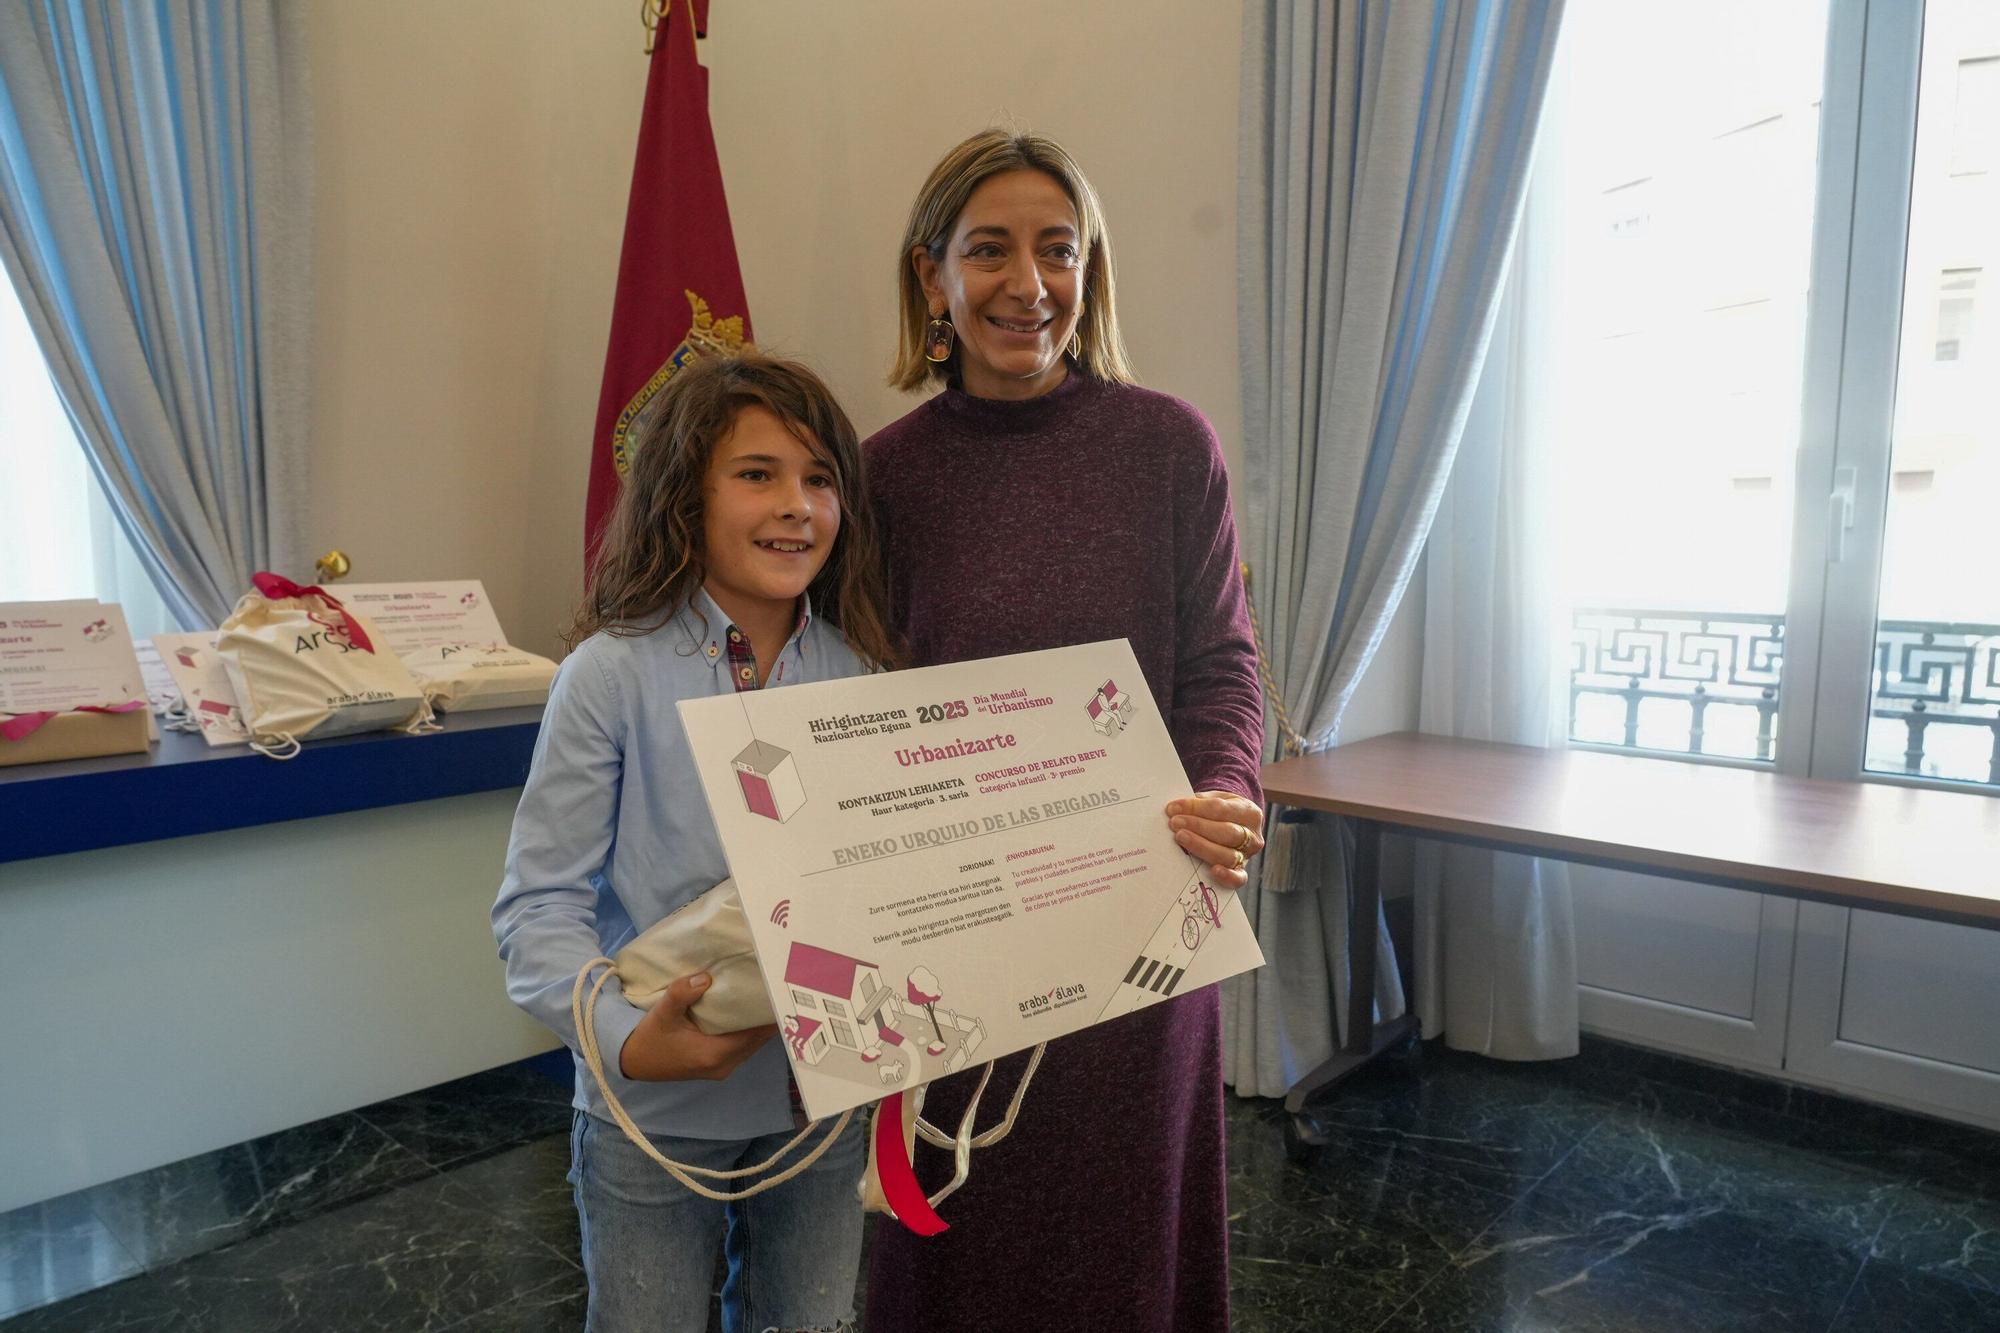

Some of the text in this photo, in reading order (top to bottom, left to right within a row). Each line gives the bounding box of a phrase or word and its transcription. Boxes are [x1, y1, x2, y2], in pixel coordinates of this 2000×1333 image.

[988, 696, 1053, 714] Urbanismo
[991, 688, 1027, 701] Mundial
[809, 700, 968, 732] Hirigintzaren 2025
[814, 722, 911, 743] Nazioarteko Eguna
[895, 734, 1016, 767] Urbanizarte
[975, 749, 1107, 782] CONCURSO DE RELATO BREVE
[1018, 774, 1046, 786] infantil
[1060, 766, 1085, 779] premio
[838, 778, 965, 810] KONTAKIZUN LEHIAKETA
[872, 807, 892, 816] Haur
[894, 797, 935, 811] kategoria
[949, 790, 969, 801] saria
[832, 788, 1120, 865] ENEKO URQUIJO DE LAS REIGADAS
[959, 859, 994, 873] ZORIONAK!
[1021, 863, 1052, 876] creatividad
[1065, 854, 1087, 864] manera
[1096, 847, 1114, 856] contar
[1015, 876, 1039, 888] pueblos
[1044, 868, 1069, 879] ciudades
[1022, 894, 1044, 904] Gracias
[1045, 891, 1055, 900] por
[1101, 873, 1122, 882] manera
[869, 906, 885, 915] Zure
[886, 899, 915, 910] sormena
[928, 890, 948, 899] herria
[960, 884, 971, 892] hiri
[972, 876, 1002, 889] atseginak
[898, 904, 934, 918] kontatzeko
[935, 898, 957, 907] modua
[958, 892, 980, 902] saritua
[1058, 894, 1074, 904] pinta
[873, 902, 1011, 944] Eskerrik asko hirigintza nola margotzen den
[902, 911, 1014, 946] modu desberdin bat erakusteagatik.
[1019, 984, 1085, 1011] araba álava
